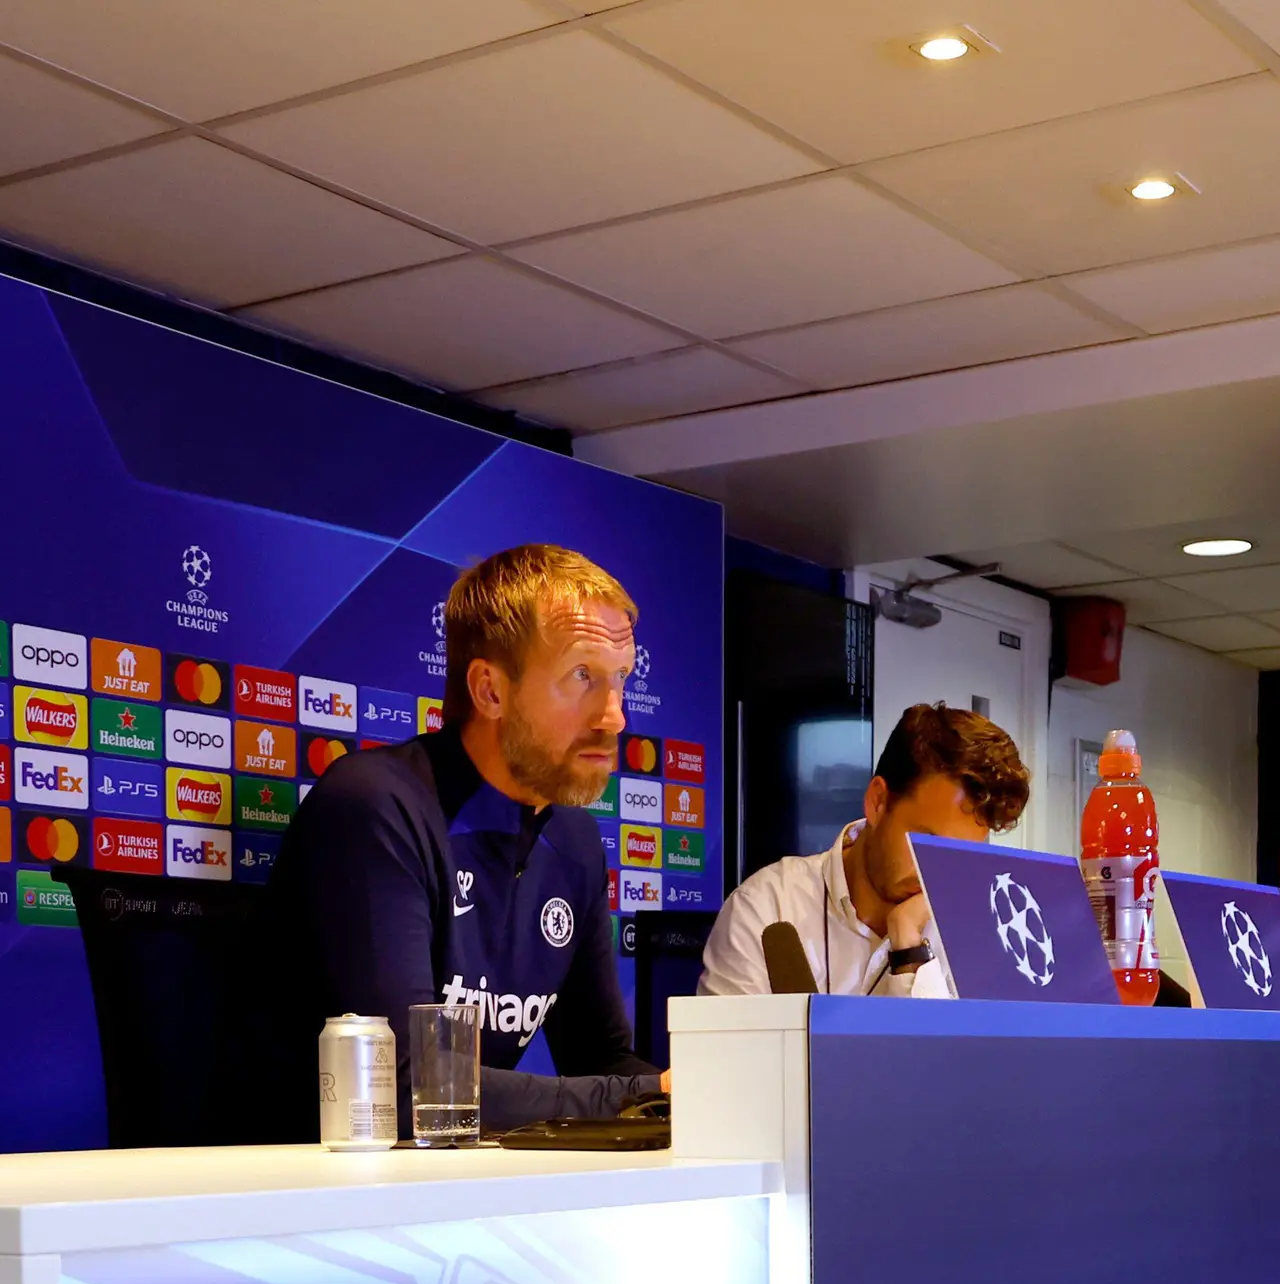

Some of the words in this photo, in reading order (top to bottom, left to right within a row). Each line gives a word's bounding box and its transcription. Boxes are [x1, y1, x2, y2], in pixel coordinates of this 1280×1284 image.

[166, 601, 229, 622] CHAMPIONS
[177, 615, 218, 633] LEAGUE
[21, 645, 79, 668] oppo
[103, 676, 128, 690] JUST
[131, 679, 150, 694] EAT
[256, 682, 291, 697] TURKISH
[255, 695, 292, 708] AIRLINES
[304, 689, 353, 719] FedEx
[628, 702, 654, 714] LEAGUE
[26, 705, 76, 729] WALKERS
[380, 708, 411, 723] PS5
[100, 730, 155, 751] Heineken
[173, 729, 224, 749] oppo
[246, 758, 267, 768] JUST
[269, 759, 286, 770] EAT
[22, 761, 83, 793] FedEx
[119, 783, 158, 797] PS5
[178, 785, 220, 805] WALKERS
[625, 793, 658, 808] oppo
[242, 807, 290, 824] Heineken
[672, 811, 685, 822] JUST
[118, 834, 158, 849] TURKISH
[628, 838, 656, 852] WALKERS
[117, 846, 158, 859] AIRLINES
[173, 839, 227, 866] FedEx
[668, 853, 700, 866] Heineken
[624, 880, 659, 902] FedEx
[680, 890, 702, 902] PS5
[39, 893, 76, 906] RESPE
